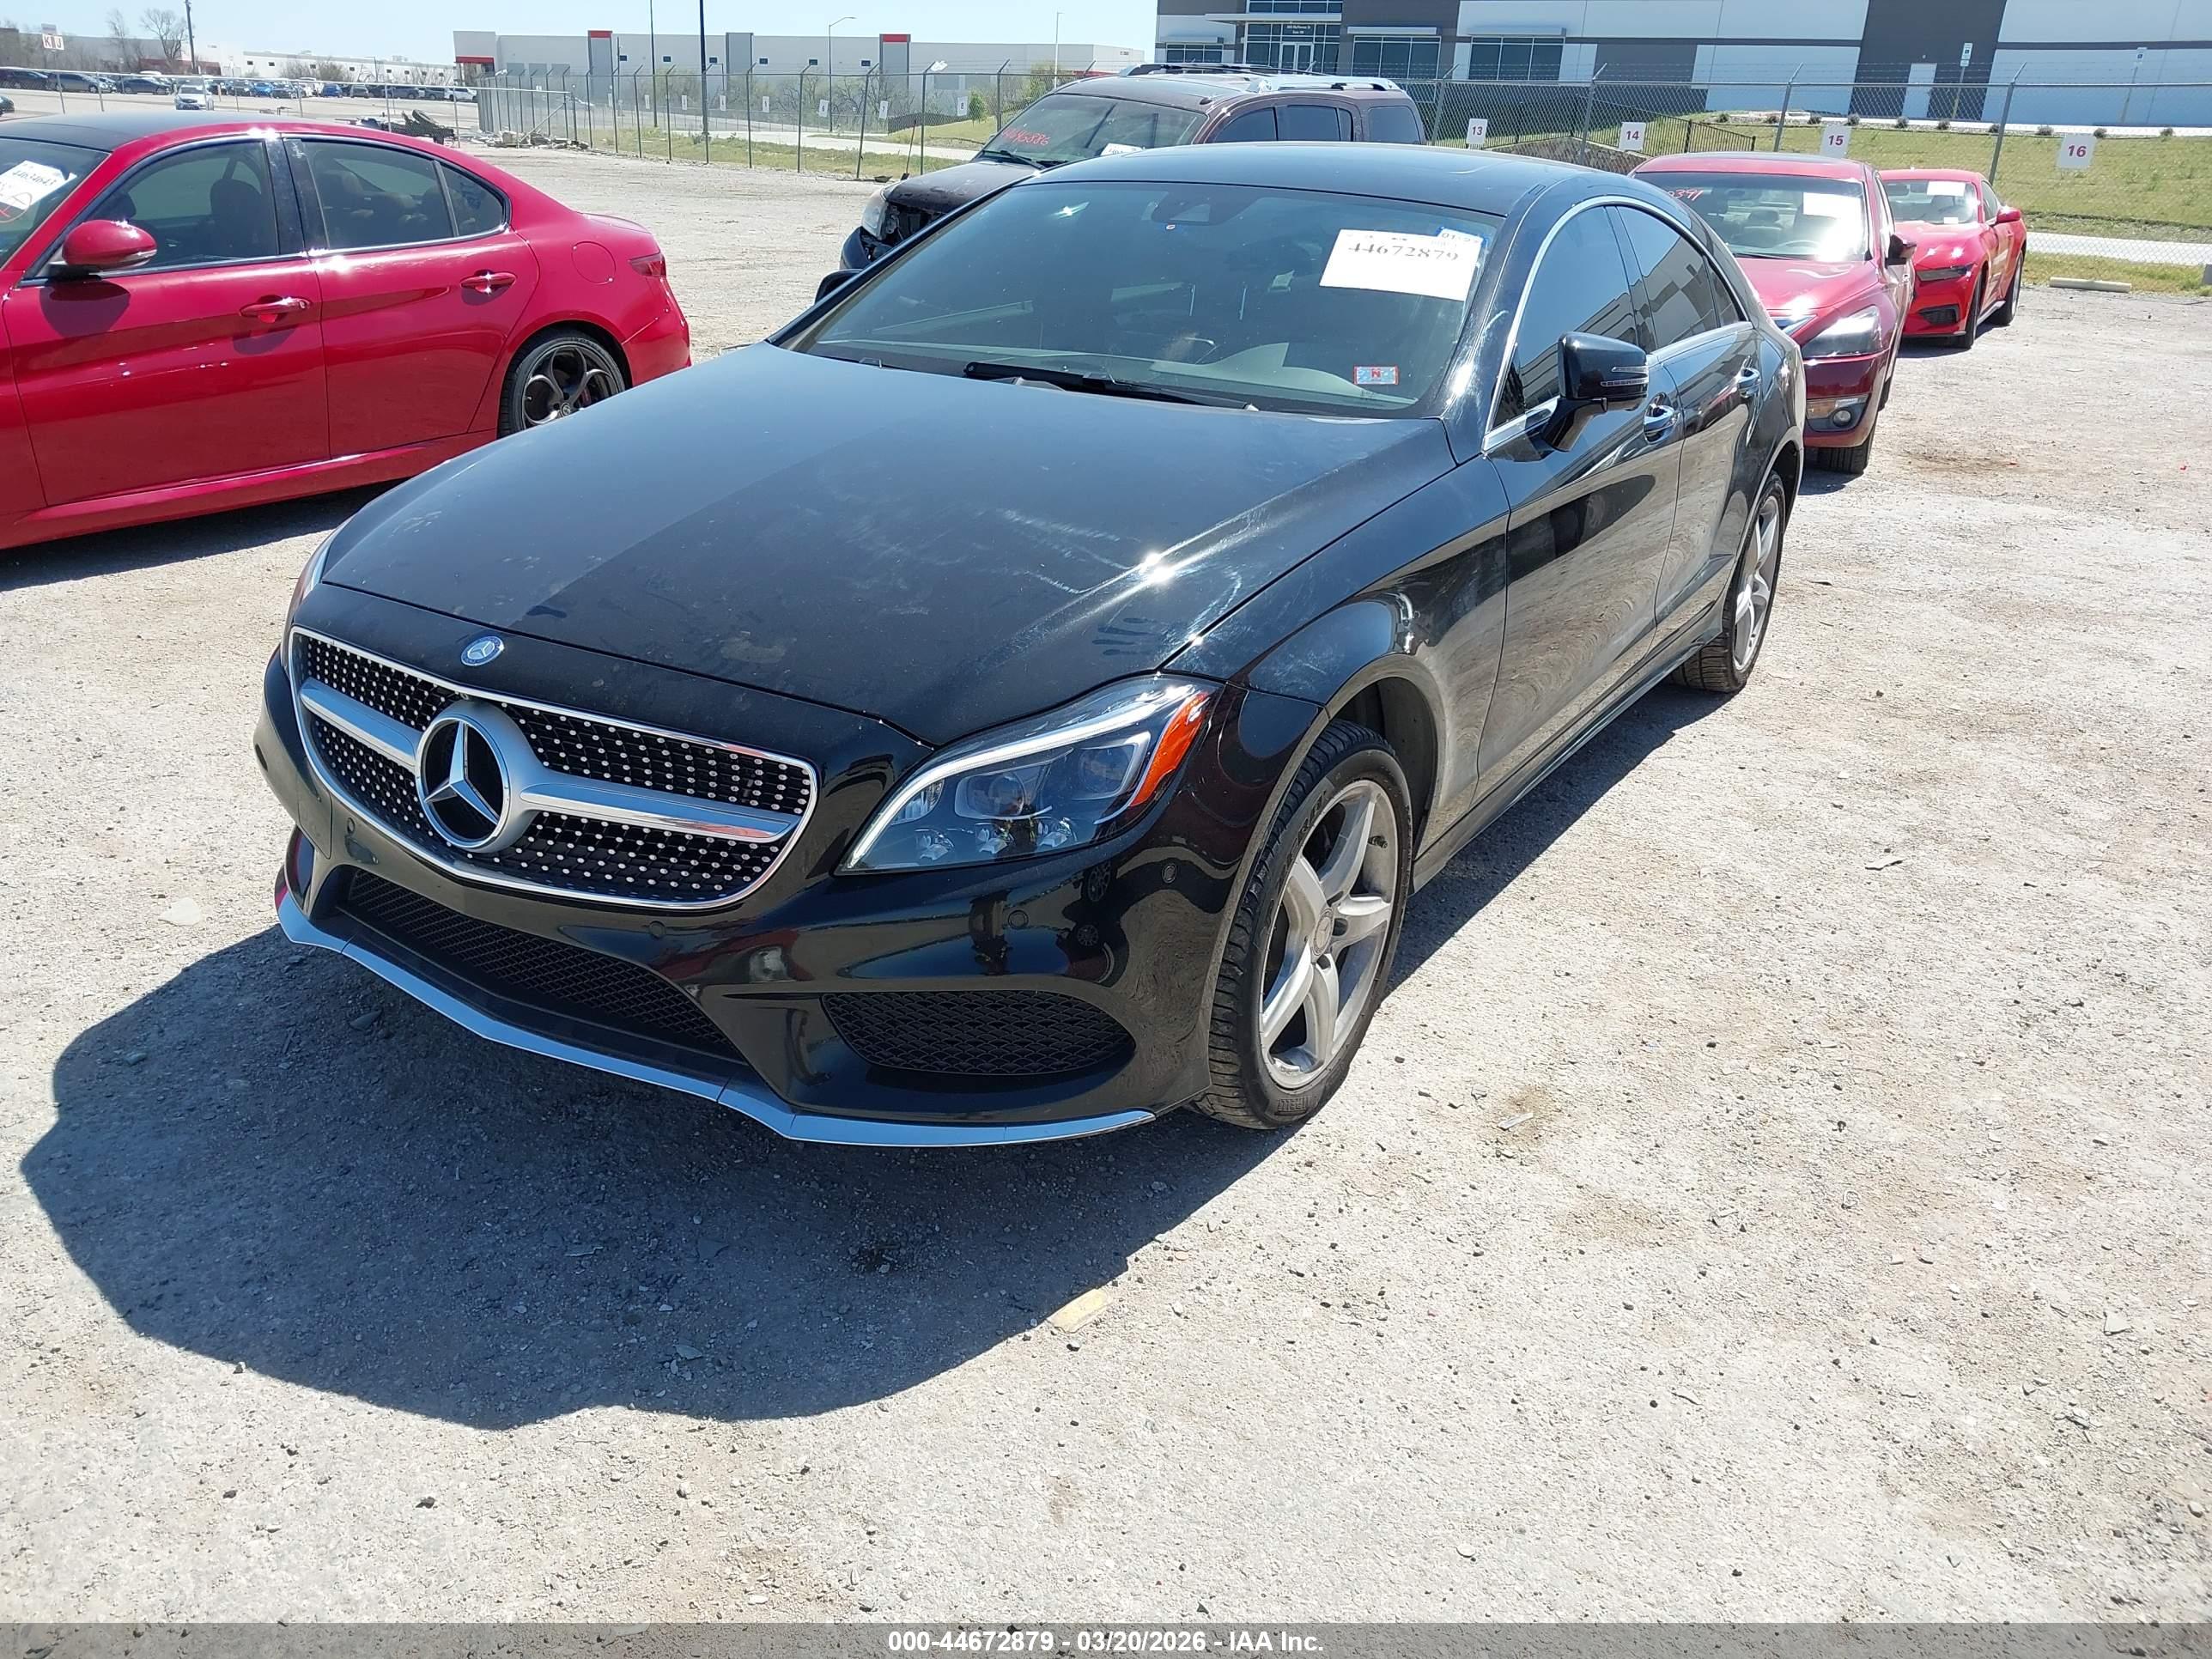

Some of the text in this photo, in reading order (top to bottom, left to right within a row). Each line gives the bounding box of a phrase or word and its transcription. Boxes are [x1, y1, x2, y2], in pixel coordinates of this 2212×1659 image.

[1471, 125, 1484, 136] 13
[1626, 130, 1639, 141] 14
[1827, 135, 1844, 145] 15
[2068, 144, 2087, 158] 16
[1348, 242, 1459, 261] 44672879
